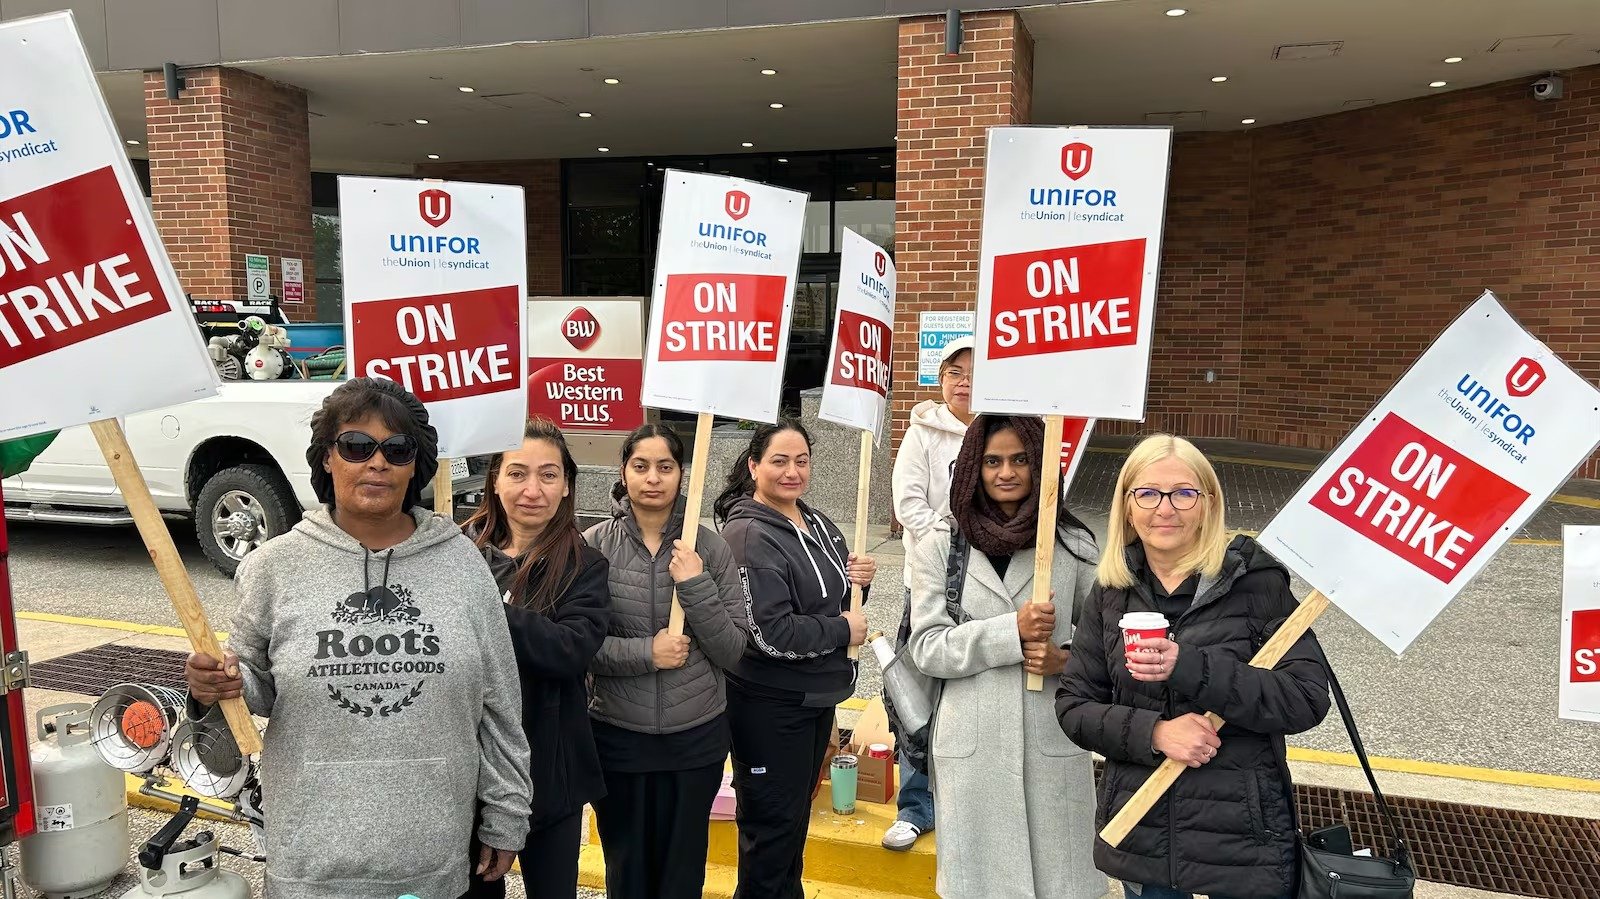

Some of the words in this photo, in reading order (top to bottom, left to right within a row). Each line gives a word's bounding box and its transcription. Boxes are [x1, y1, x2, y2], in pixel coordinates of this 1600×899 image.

[1020, 210, 1065, 222] theUnion
[1073, 210, 1125, 223] lesyndicat
[382, 257, 430, 268] theUnion
[438, 258, 490, 270] lesyndicat
[1026, 257, 1080, 299] ON
[693, 282, 736, 313] ON
[396, 303, 457, 346] ON
[566, 320, 596, 338] BW
[665, 321, 774, 352] STRIKE
[859, 321, 882, 353] ON
[994, 297, 1132, 348] STRIKE
[922, 333, 937, 346] 10
[563, 364, 605, 382] Best
[546, 382, 624, 402] Western
[1391, 441, 1457, 501] ON
[1328, 467, 1475, 571] STRIKE
[313, 628, 441, 660] Roots
[306, 661, 390, 677] ATHLETIC
[392, 661, 446, 674] GOODS
[354, 682, 400, 691] CANADA
